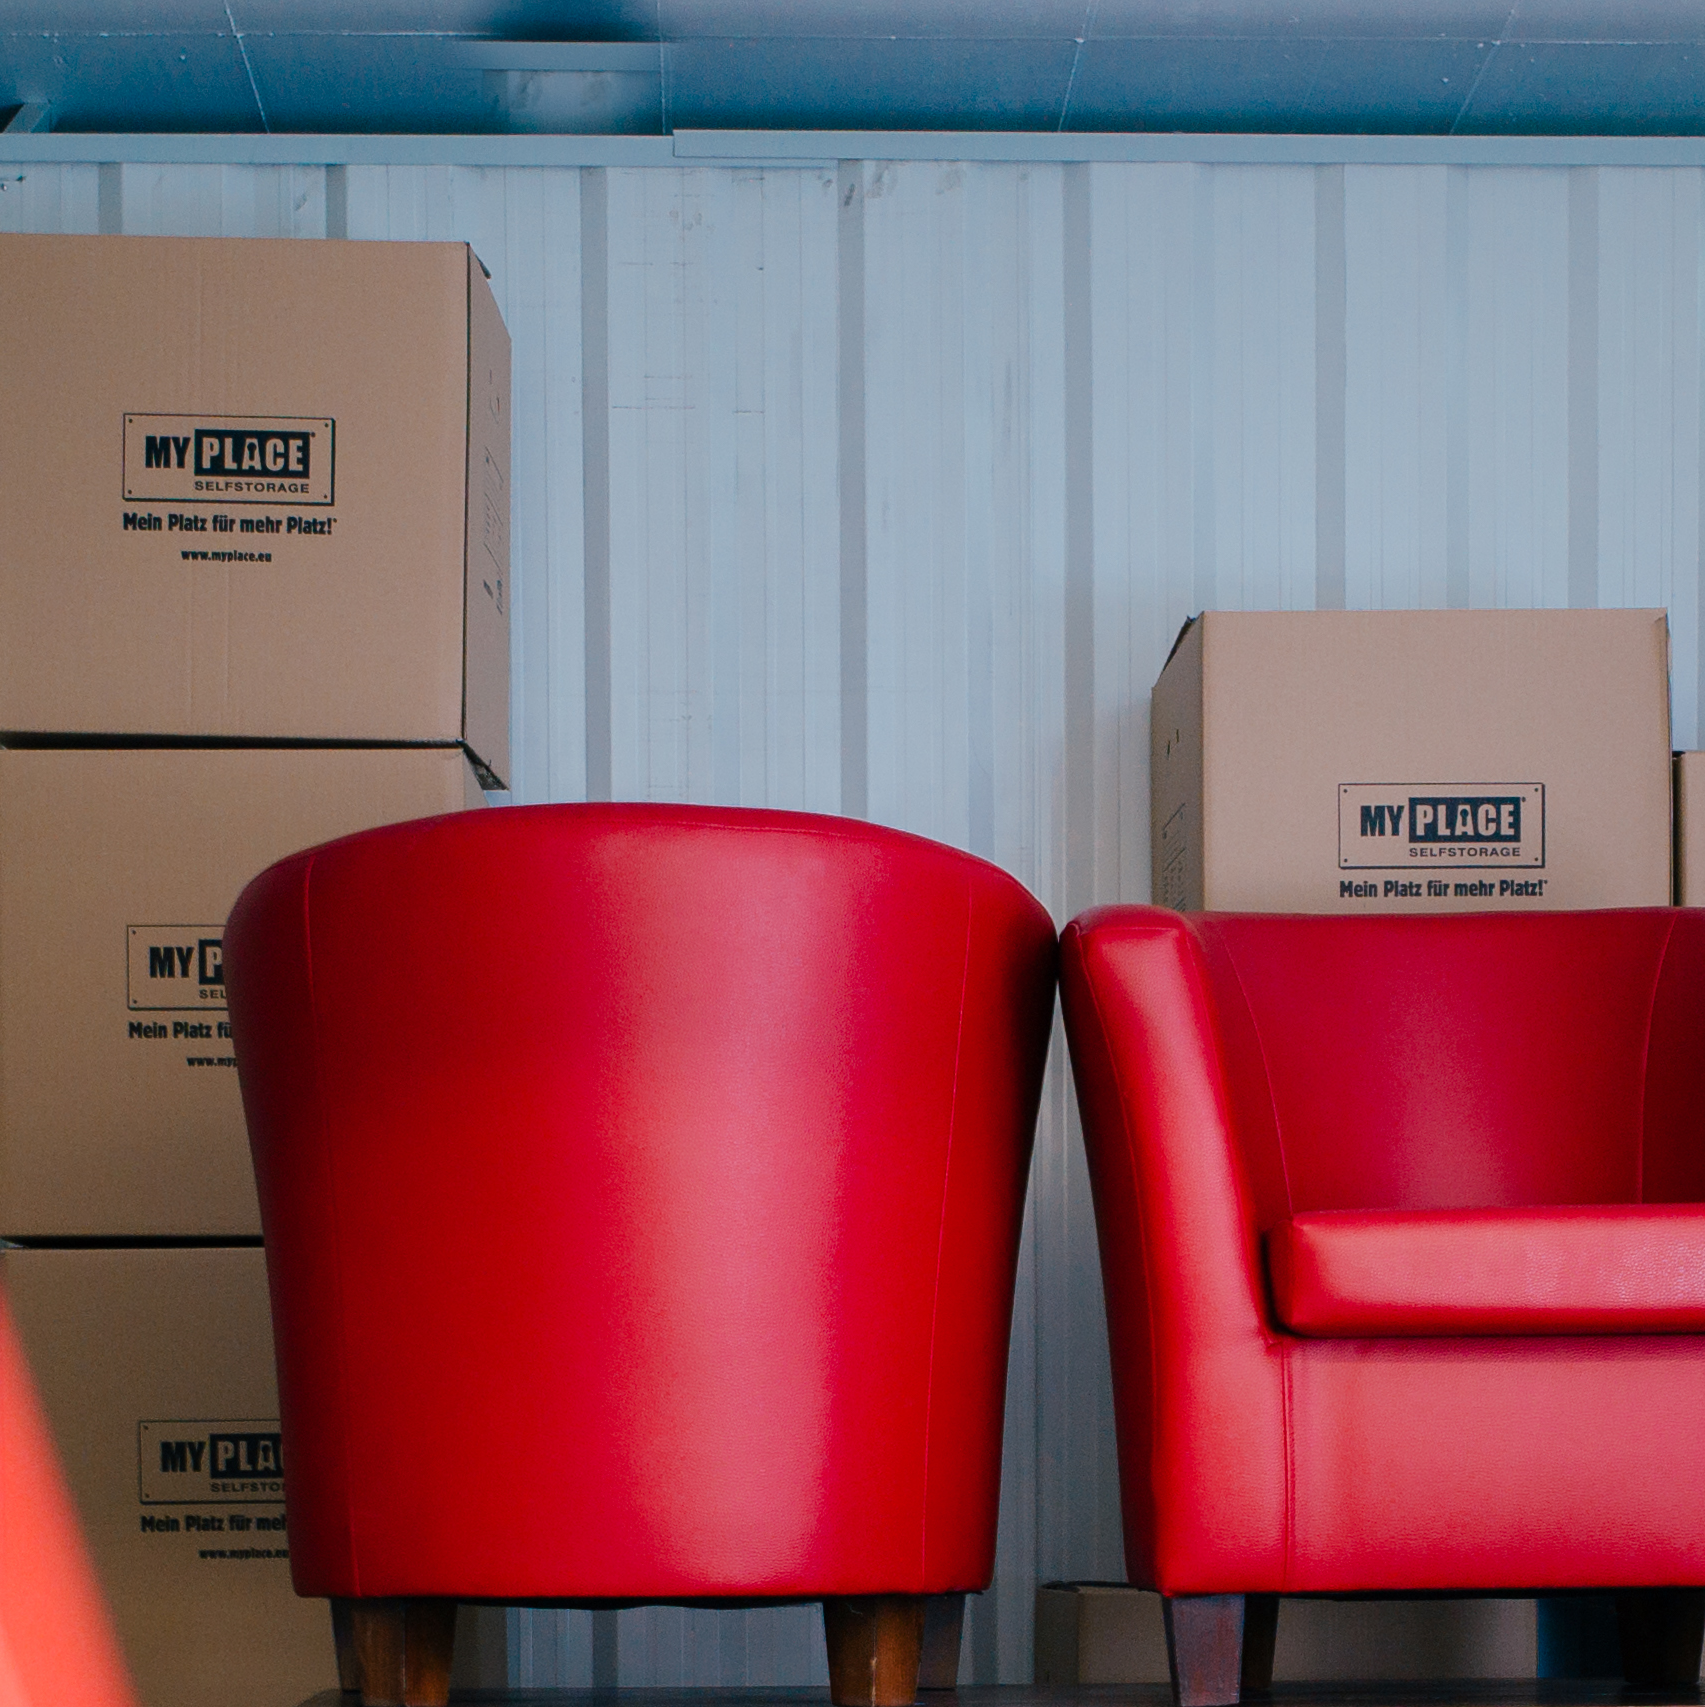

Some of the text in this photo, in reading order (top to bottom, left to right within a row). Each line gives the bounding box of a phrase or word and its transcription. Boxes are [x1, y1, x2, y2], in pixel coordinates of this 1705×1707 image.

[145, 436, 304, 472] MY PLACE
[194, 480, 309, 493] SELFSTORAGE
[123, 513, 332, 534] Mein Platz für mehr Platz!
[181, 550, 272, 563] www.myplace.eu
[1360, 803, 1515, 836] MY PLACE
[1409, 847, 1521, 857] SELFSTORAGE
[1339, 879, 1543, 898] Mein Platz für mehr Platz!
[149, 947, 194, 978] MY
[129, 1021, 233, 1039] Mein Platz fü
[160, 1440, 283, 1473] MY PLA
[210, 1482, 285, 1493] SELFSTO
[141, 1515, 180, 1532] Mein
[185, 1515, 225, 1532] Platz
[229, 1515, 252, 1532] für
